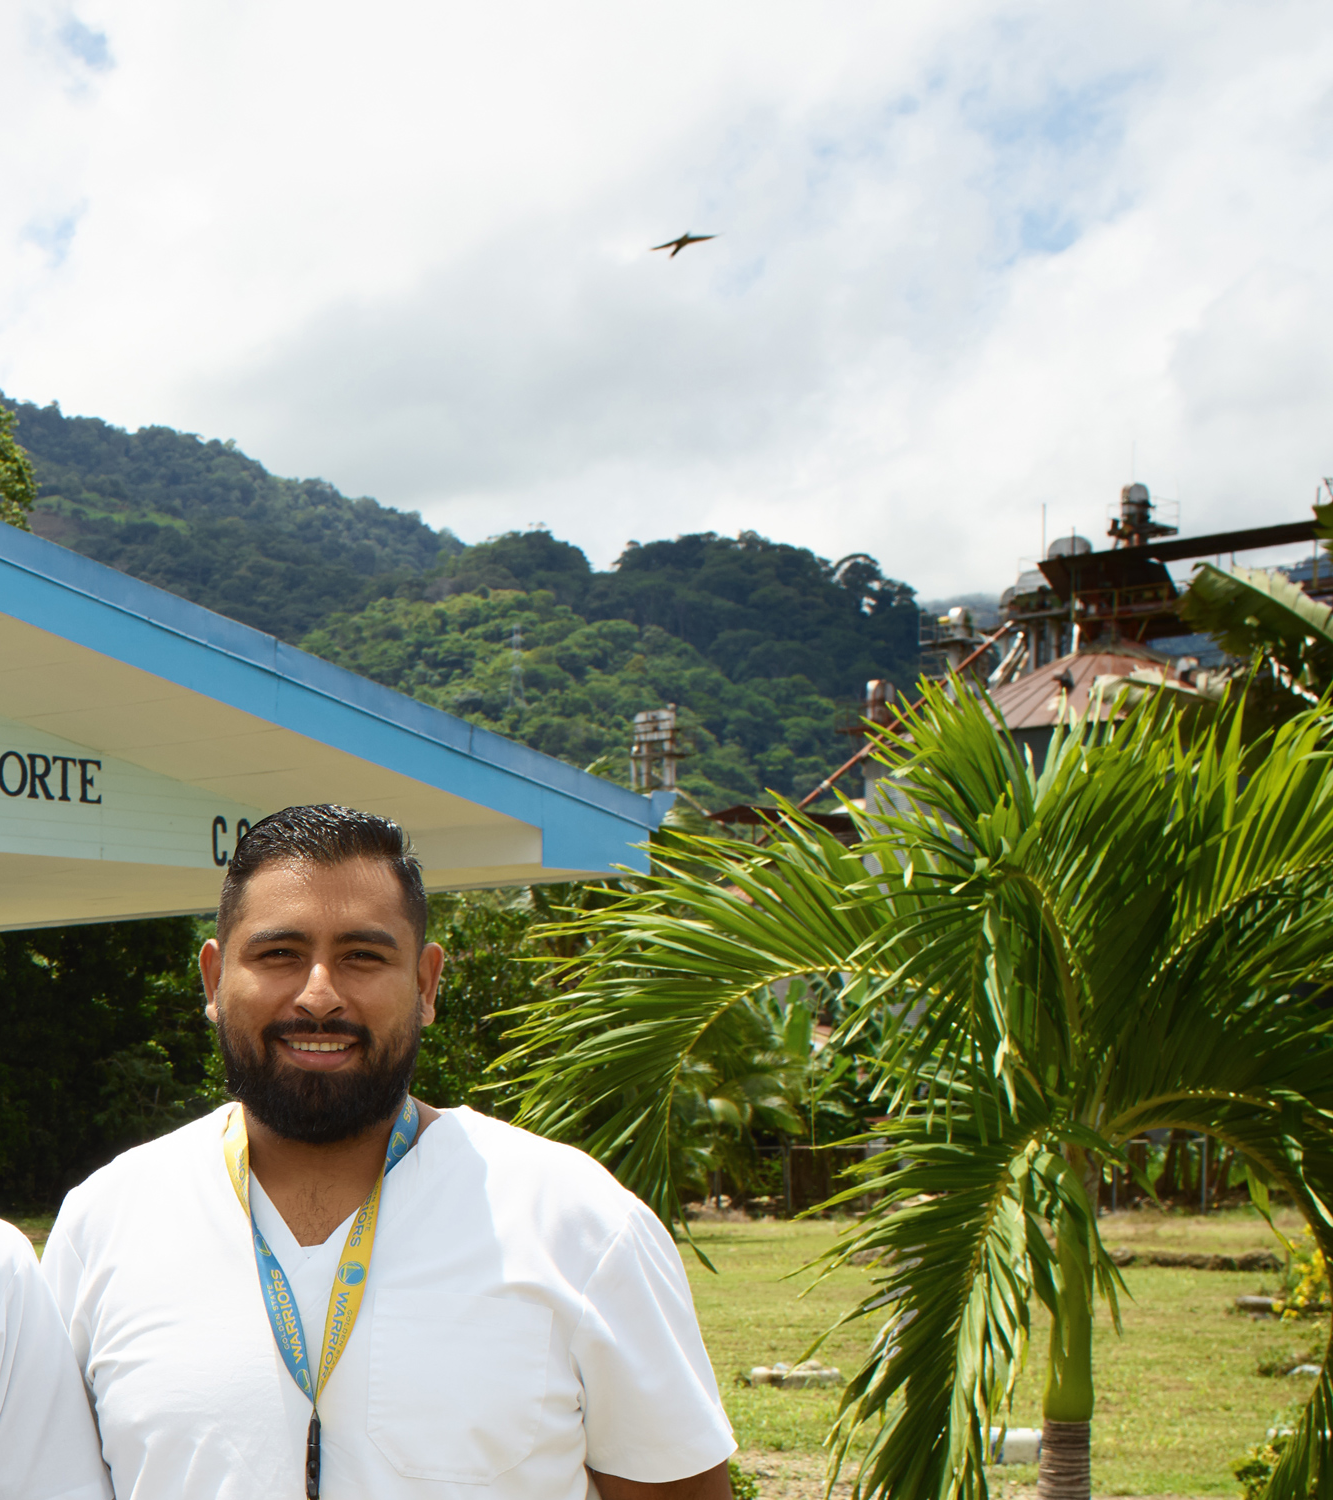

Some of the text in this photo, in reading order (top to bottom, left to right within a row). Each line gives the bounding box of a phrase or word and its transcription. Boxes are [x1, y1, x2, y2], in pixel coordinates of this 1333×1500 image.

[350, 1191, 372, 1248] RIORS
[267, 1284, 290, 1351] GOLDEN STATE
[270, 1269, 304, 1364] WARRIORS
[338, 1309, 353, 1347] GOLDEN
